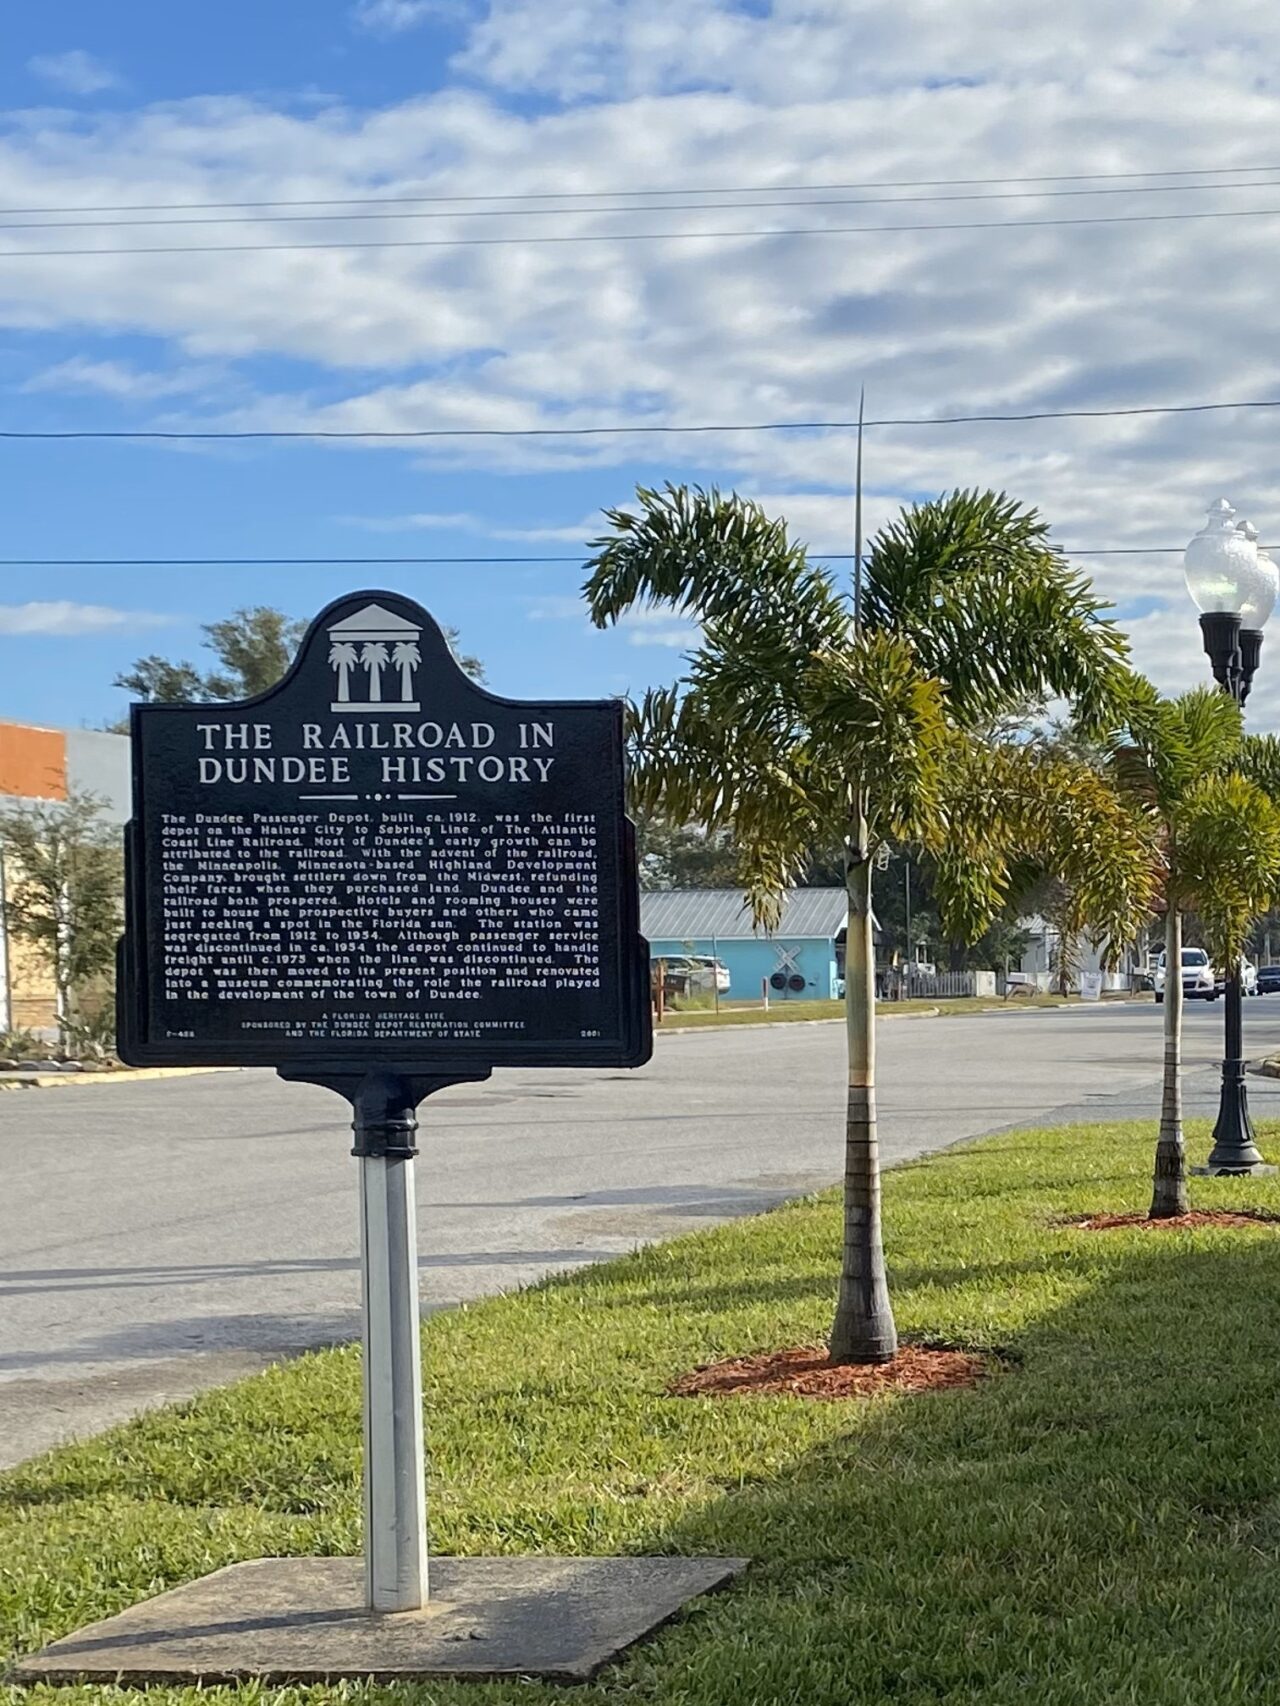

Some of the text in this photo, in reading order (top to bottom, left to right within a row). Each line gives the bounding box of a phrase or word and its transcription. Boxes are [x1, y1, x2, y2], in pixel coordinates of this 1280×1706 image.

[197, 722, 553, 750] THE RAILROAD IN
[198, 757, 554, 784] DUNDEE HISTORY
[162, 813, 595, 826] The Dundee Passenger built was the first
[162, 825, 596, 838] depot on the Haines City to Sebring Line of The Atlantic
[162, 838, 198, 848] Coast
[207, 838, 234, 848] Line
[315, 838, 345, 848] Most
[353, 838, 365, 848] of
[445, 837, 480, 849] early
[491, 837, 538, 849] growth
[548, 839, 571, 847] can
[582, 837, 596, 847] be
[163, 850, 230, 859] attributed
[238, 850, 250, 859] to
[260, 850, 279, 859] the
[362, 850, 391, 859] With
[401, 849, 421, 858] the
[431, 849, 474, 858] advent
[485, 849, 496, 858] of
[507, 849, 527, 858] the
[163, 861, 183, 871] the
[429, 861, 491, 872] Highland
[508, 861, 596, 872] Development
[234, 874, 285, 885] brought
[294, 874, 345, 883] settlers
[353, 874, 387, 883] down
[396, 873, 426, 882] from
[438, 873, 458, 882] the
[531, 873, 597, 884] refunding
[164, 885, 197, 894] their
[208, 885, 242, 894] fares
[256, 885, 290, 894] when
[305, 885, 333, 896] they
[347, 885, 418, 896] purchased
[481, 885, 530, 894] Dundee
[540, 885, 563, 894] and
[576, 885, 597, 894] the
[164, 896, 217, 906] railroad
[228, 896, 258, 906] both
[357, 897, 400, 905] Hotels
[412, 897, 435, 905] and
[446, 897, 500, 907] rooming
[511, 897, 556, 905] houses
[164, 908, 194, 918] built
[202, 908, 215, 918] to
[223, 908, 259, 918] house
[269, 908, 289, 918] the
[299, 908, 378, 920] prospective
[388, 908, 433, 919] buyers
[443, 908, 466, 917] and
[476, 908, 518, 917] others
[529, 908, 554, 917] who
[165, 921, 191, 932] just
[201, 921, 253, 932] seeking
[281, 921, 309, 932] spot
[319, 921, 331, 930] in
[342, 921, 362, 930] the
[373, 920, 421, 929] Florida
[478, 920, 503, 929] The
[514, 920, 561, 929] station
[574, 921, 598, 929] was
[165, 932, 240, 944] segregated
[250, 932, 280, 942] from
[291, 932, 316, 942] 1912
[326, 932, 339, 942] to
[398, 932, 459, 943] Although
[470, 934, 539, 943] passenger
[549, 932, 598, 941] service
[196, 944, 281, 953] discontinued
[290, 944, 302, 953] in
[335, 944, 365, 953] 1954
[376, 943, 398, 952] the
[408, 943, 446, 954] depot
[456, 943, 522, 952] continued
[533, 943, 546, 952] to
[555, 943, 598, 952] handle
[165, 955, 212, 967] freight
[221, 955, 253, 965] until
[317, 955, 350, 965] when
[360, 955, 381, 965] the
[392, 954, 417, 964] line
[430, 956, 453, 964] was
[574, 954, 598, 964] The
[165, 967, 599, 979] depot was then moved to its present position and renovated
[166, 979, 599, 990] into museum commemorating the role the railroad played
[166, 990, 178, 1000] in
[187, 990, 208, 1000] the
[219, 990, 304, 1002] development
[311, 990, 325, 1000] of
[334, 990, 354, 1000] the
[365, 989, 396, 999] town
[406, 989, 420, 999] of
